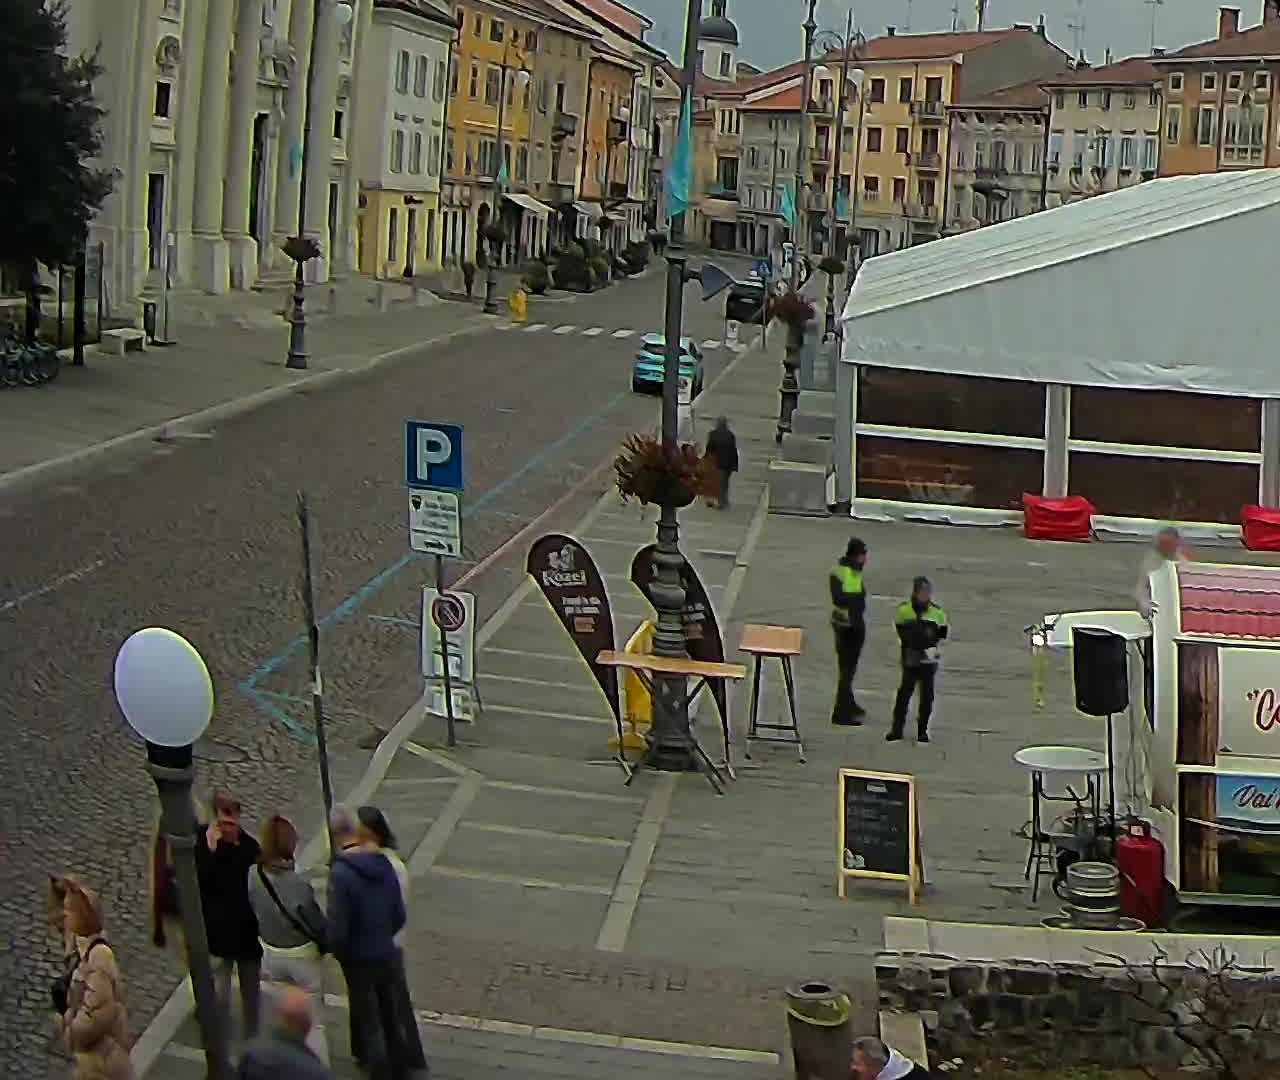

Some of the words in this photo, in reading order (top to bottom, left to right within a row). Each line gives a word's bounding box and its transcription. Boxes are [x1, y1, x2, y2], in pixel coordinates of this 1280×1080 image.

[416, 427, 452, 481] P
[542, 569, 587, 587] Kozel
[1232, 784, 1279, 808] Dai
